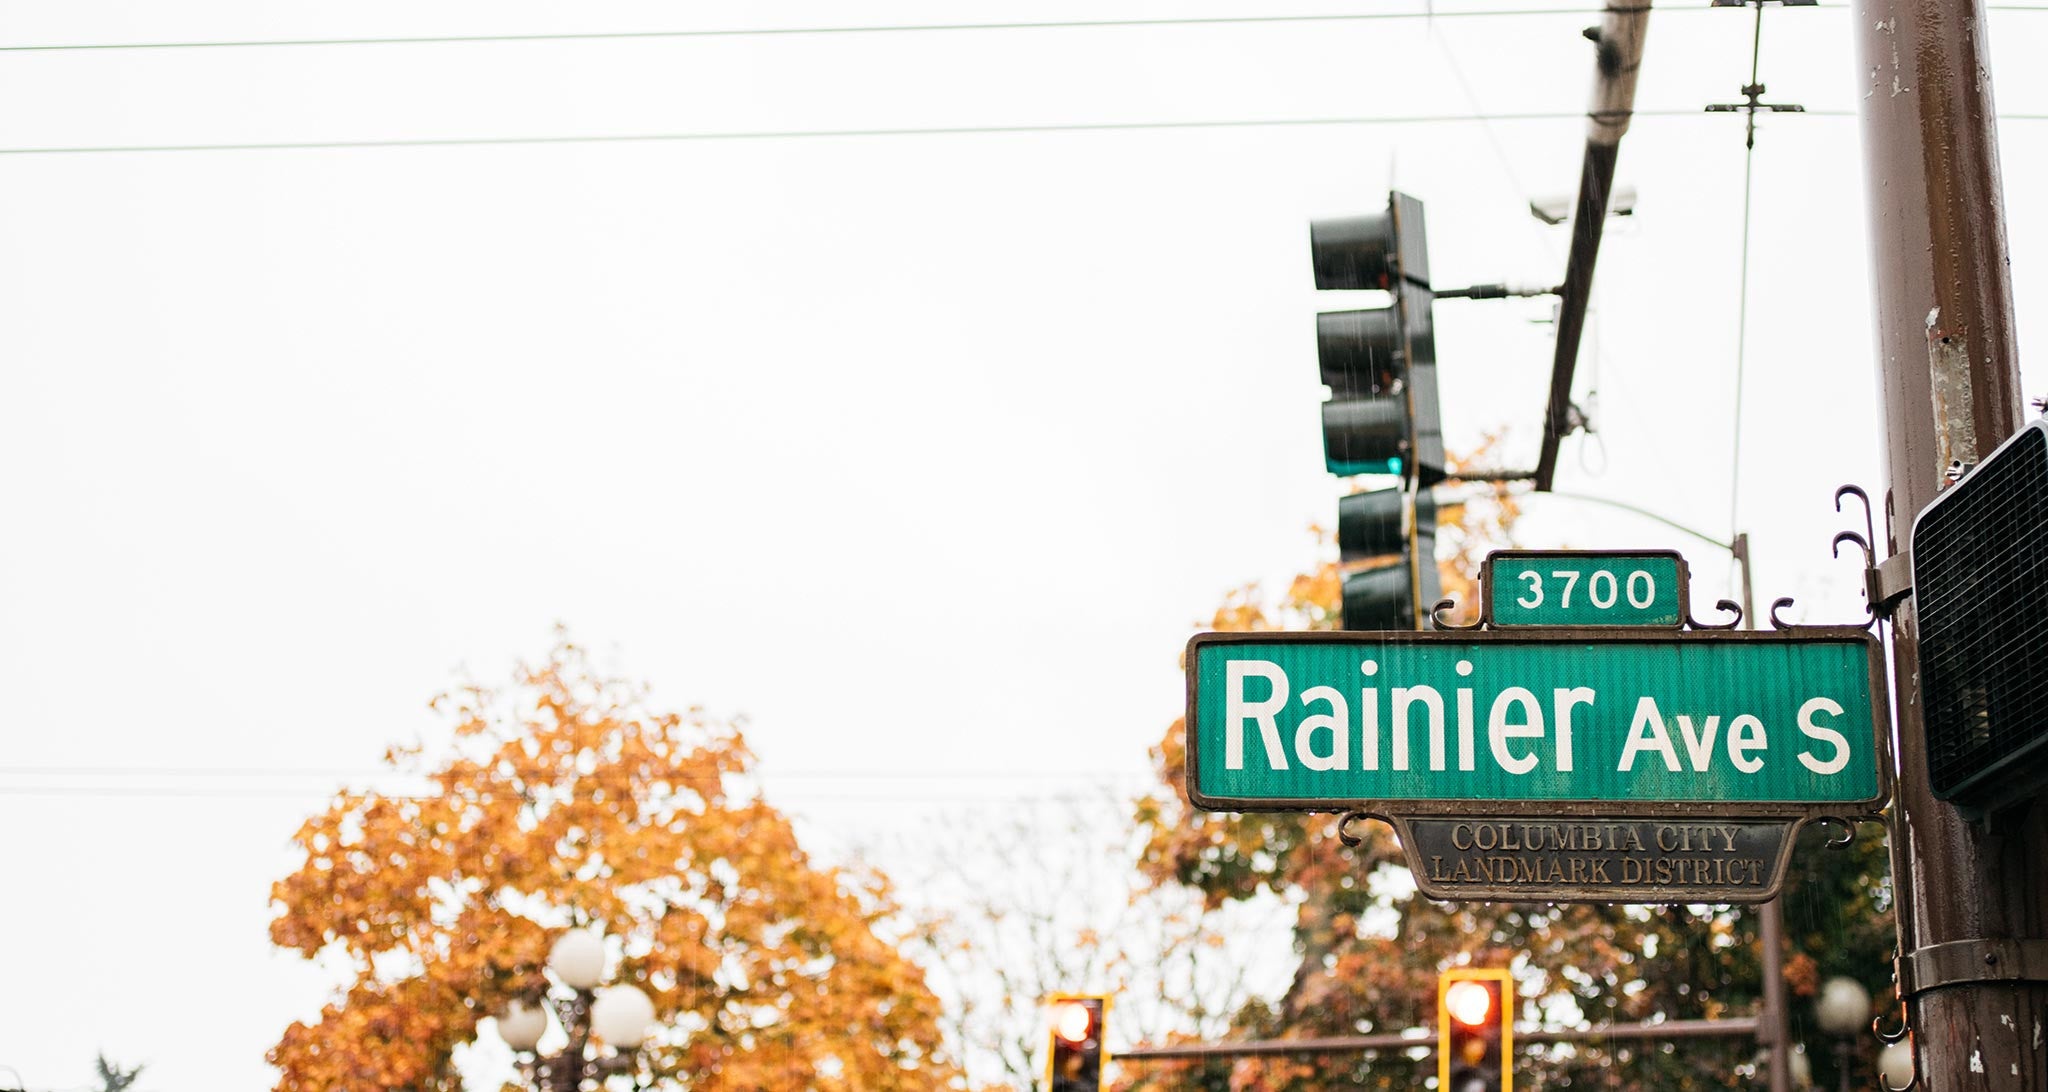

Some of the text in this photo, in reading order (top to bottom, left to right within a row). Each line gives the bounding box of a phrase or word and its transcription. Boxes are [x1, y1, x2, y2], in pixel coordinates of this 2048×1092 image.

[1516, 569, 1657, 610] 3700
[1225, 659, 1852, 775] Rainier Ave S
[1451, 824, 1741, 852] COLUMBIA CITY
[1432, 855, 1765, 885] LANDMARK DISTRICT
